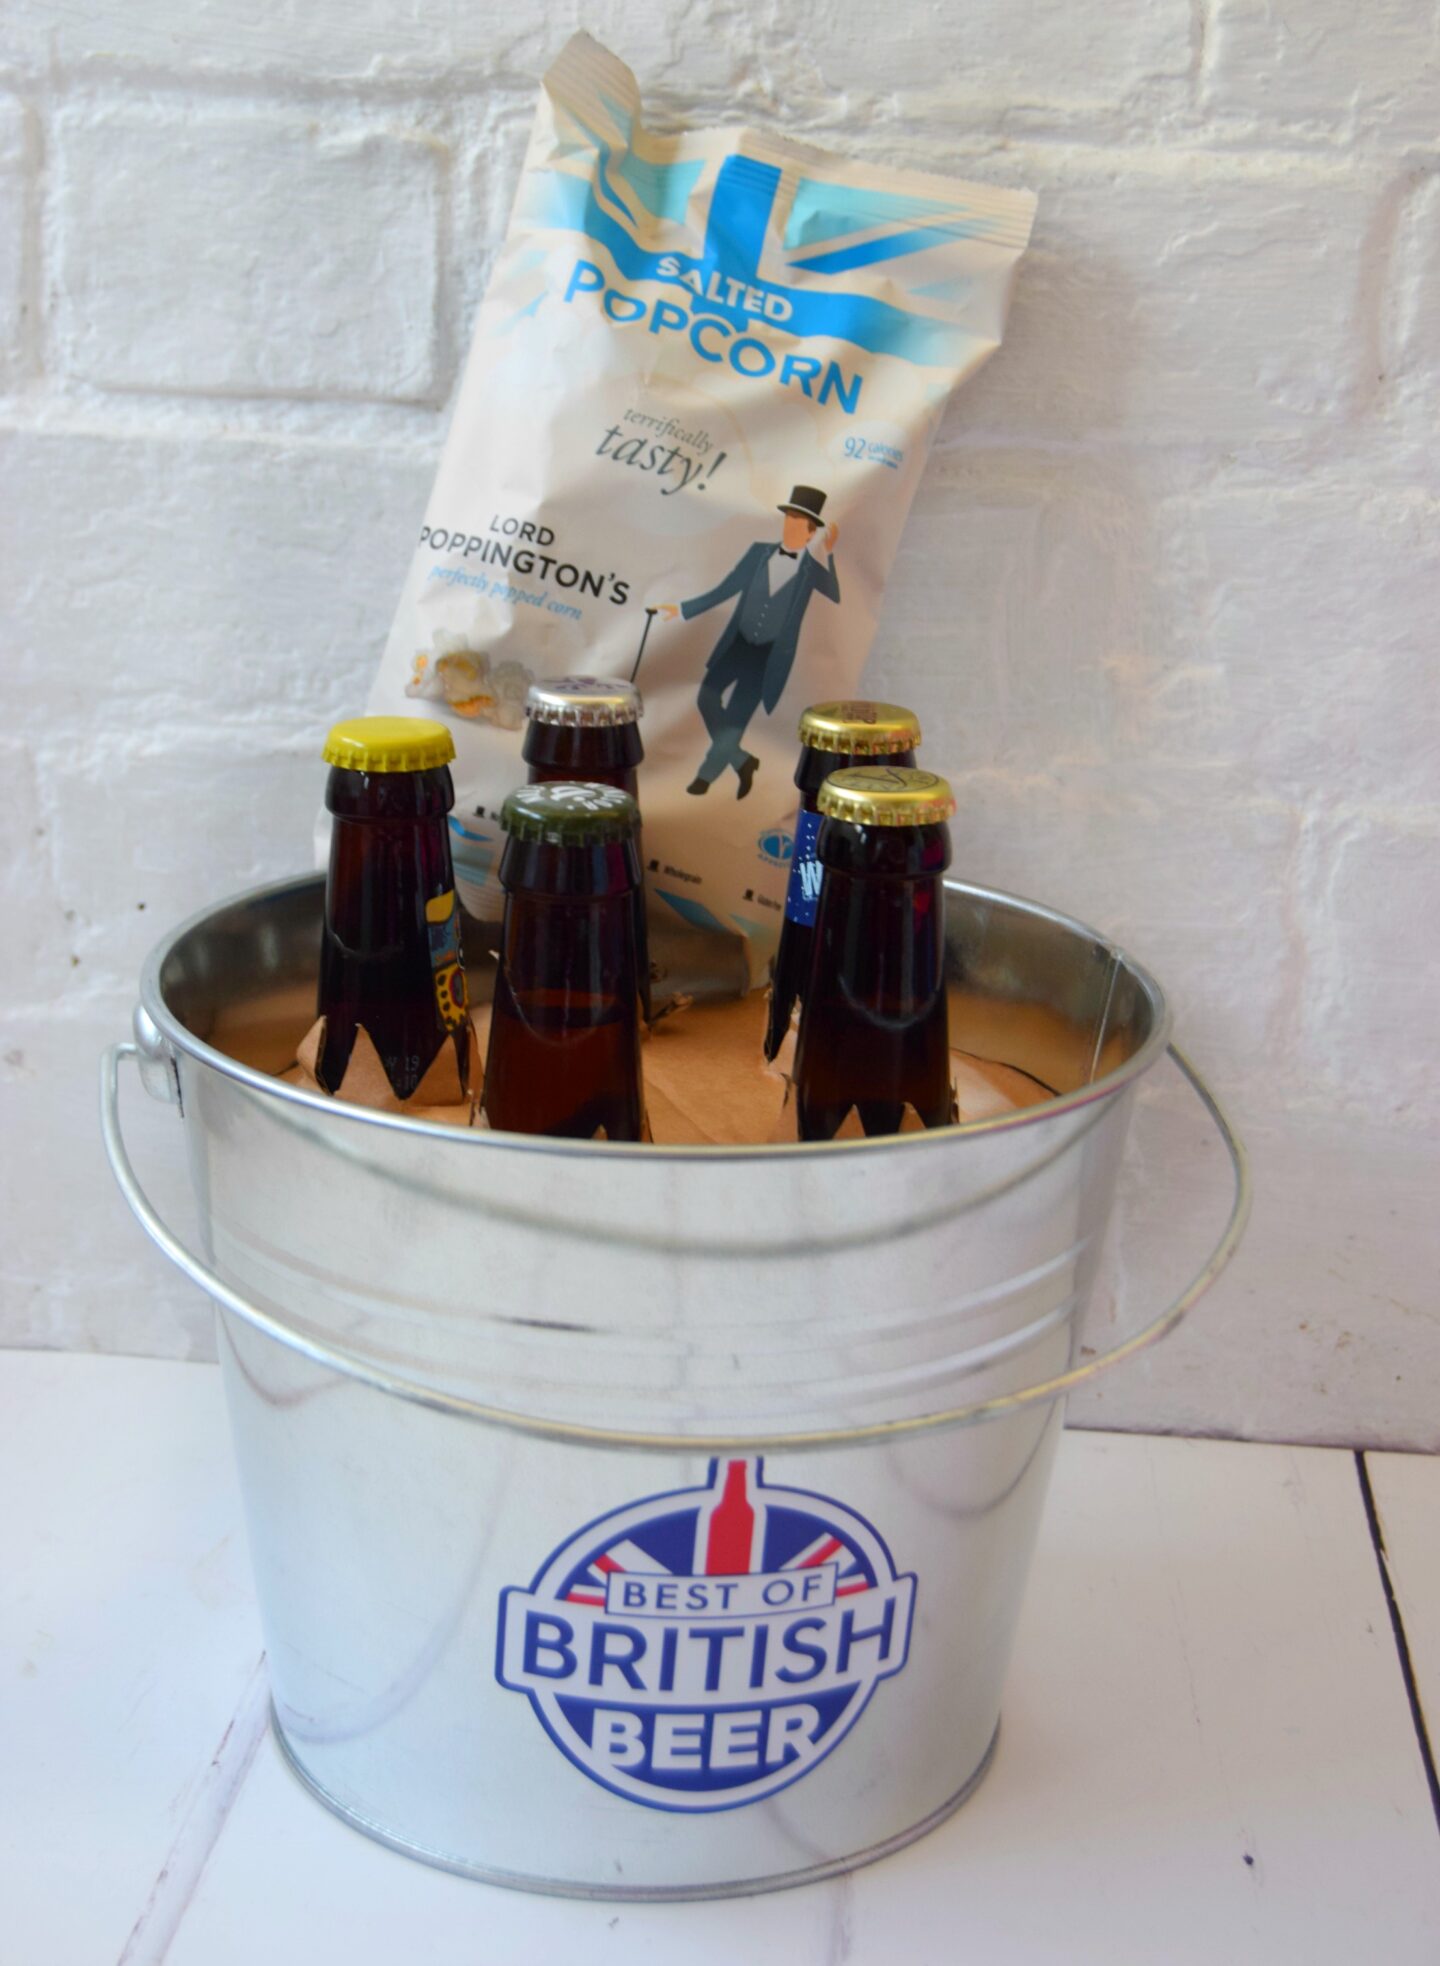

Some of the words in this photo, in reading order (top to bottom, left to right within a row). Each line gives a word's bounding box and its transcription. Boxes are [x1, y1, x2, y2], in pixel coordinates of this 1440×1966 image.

[656, 255, 794, 322] SALTED
[563, 259, 863, 415] POPCORN
[595, 425, 727, 495] tasty!
[623, 408, 715, 456] terrifically
[843, 436, 866, 460] 92
[489, 514, 555, 546] LORD
[489, 580, 549, 606] popped
[546, 599, 584, 621] corn
[621, 1581, 739, 1610] BEST
[761, 1574, 823, 1607] OF
[522, 1596, 896, 1691] BRITISH
[590, 1703, 820, 1770] BEER
